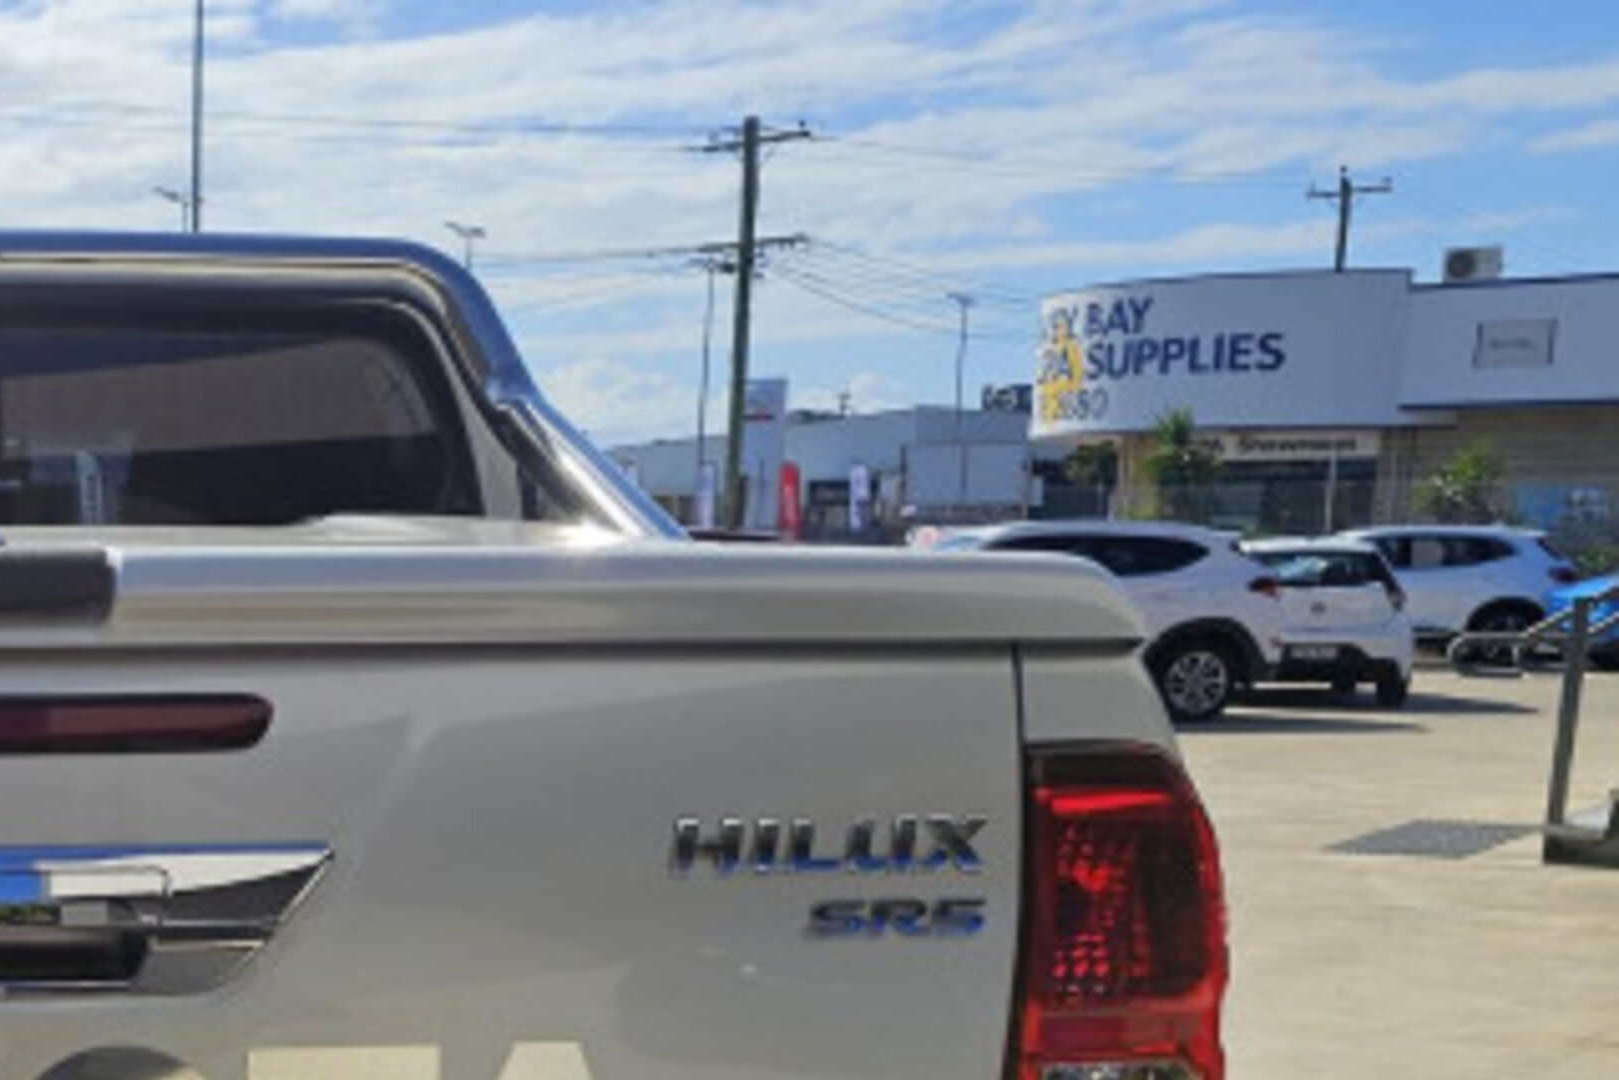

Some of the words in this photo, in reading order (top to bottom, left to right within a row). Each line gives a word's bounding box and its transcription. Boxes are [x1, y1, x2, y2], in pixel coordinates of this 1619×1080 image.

[1085, 297, 1154, 336] BAY
[1085, 332, 1287, 380] SUPPLIES
[672, 811, 988, 876] HILUX
[806, 898, 987, 937] SR5
